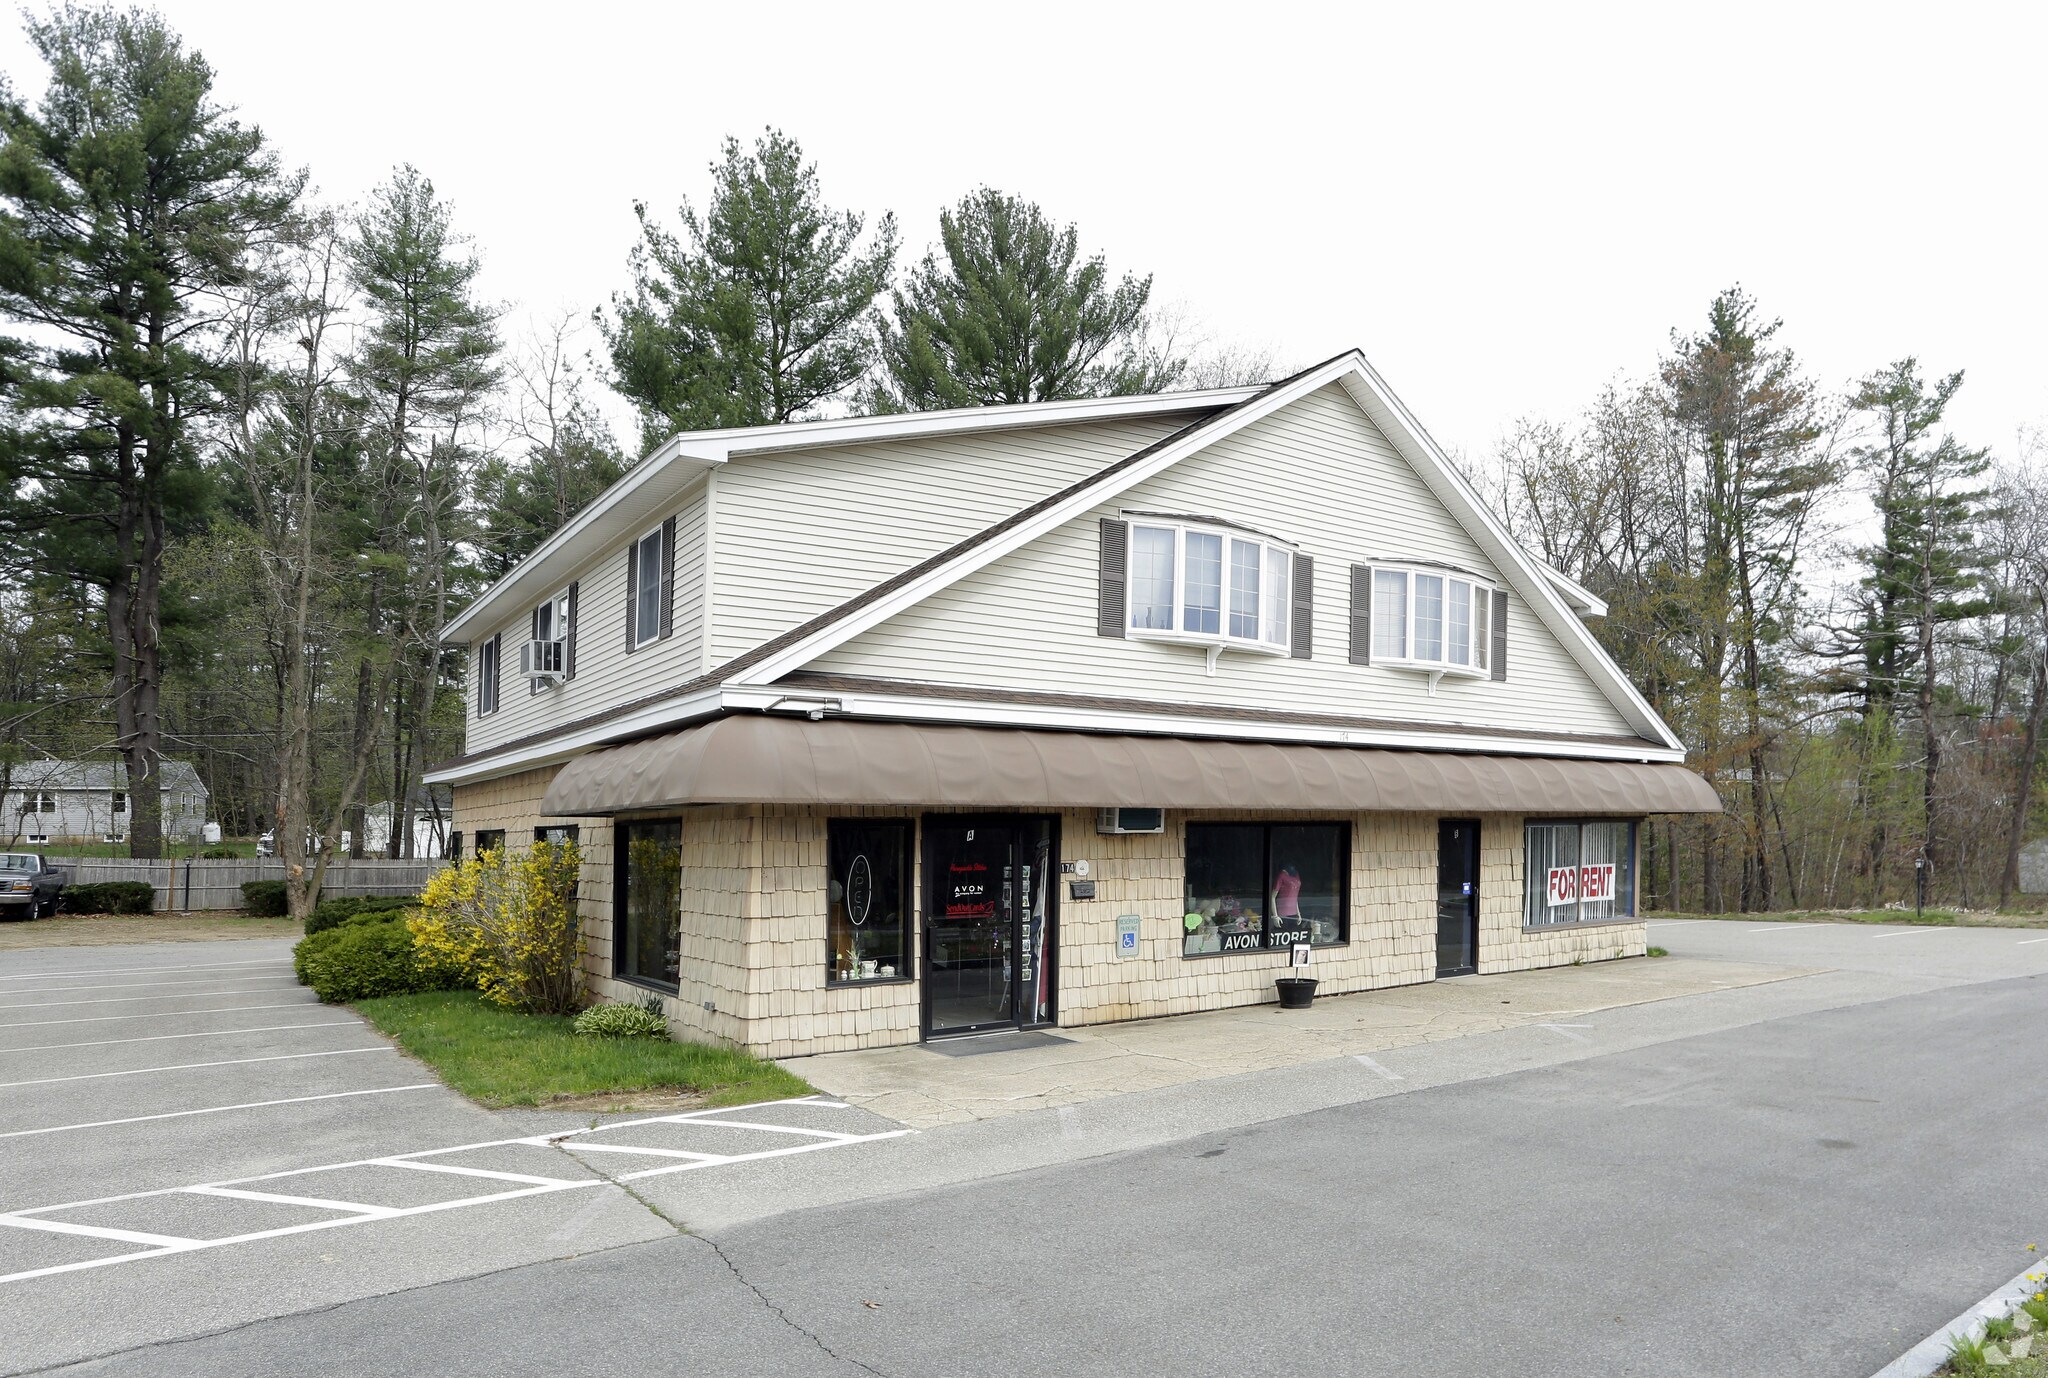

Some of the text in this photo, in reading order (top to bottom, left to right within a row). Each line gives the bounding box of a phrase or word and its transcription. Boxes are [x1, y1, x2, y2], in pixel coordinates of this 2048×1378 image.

[1061, 863, 1074, 873] 174
[954, 885, 984, 893] AVON
[1549, 866, 1613, 901] FOR RENT
[1224, 934, 1260, 950] AVON
